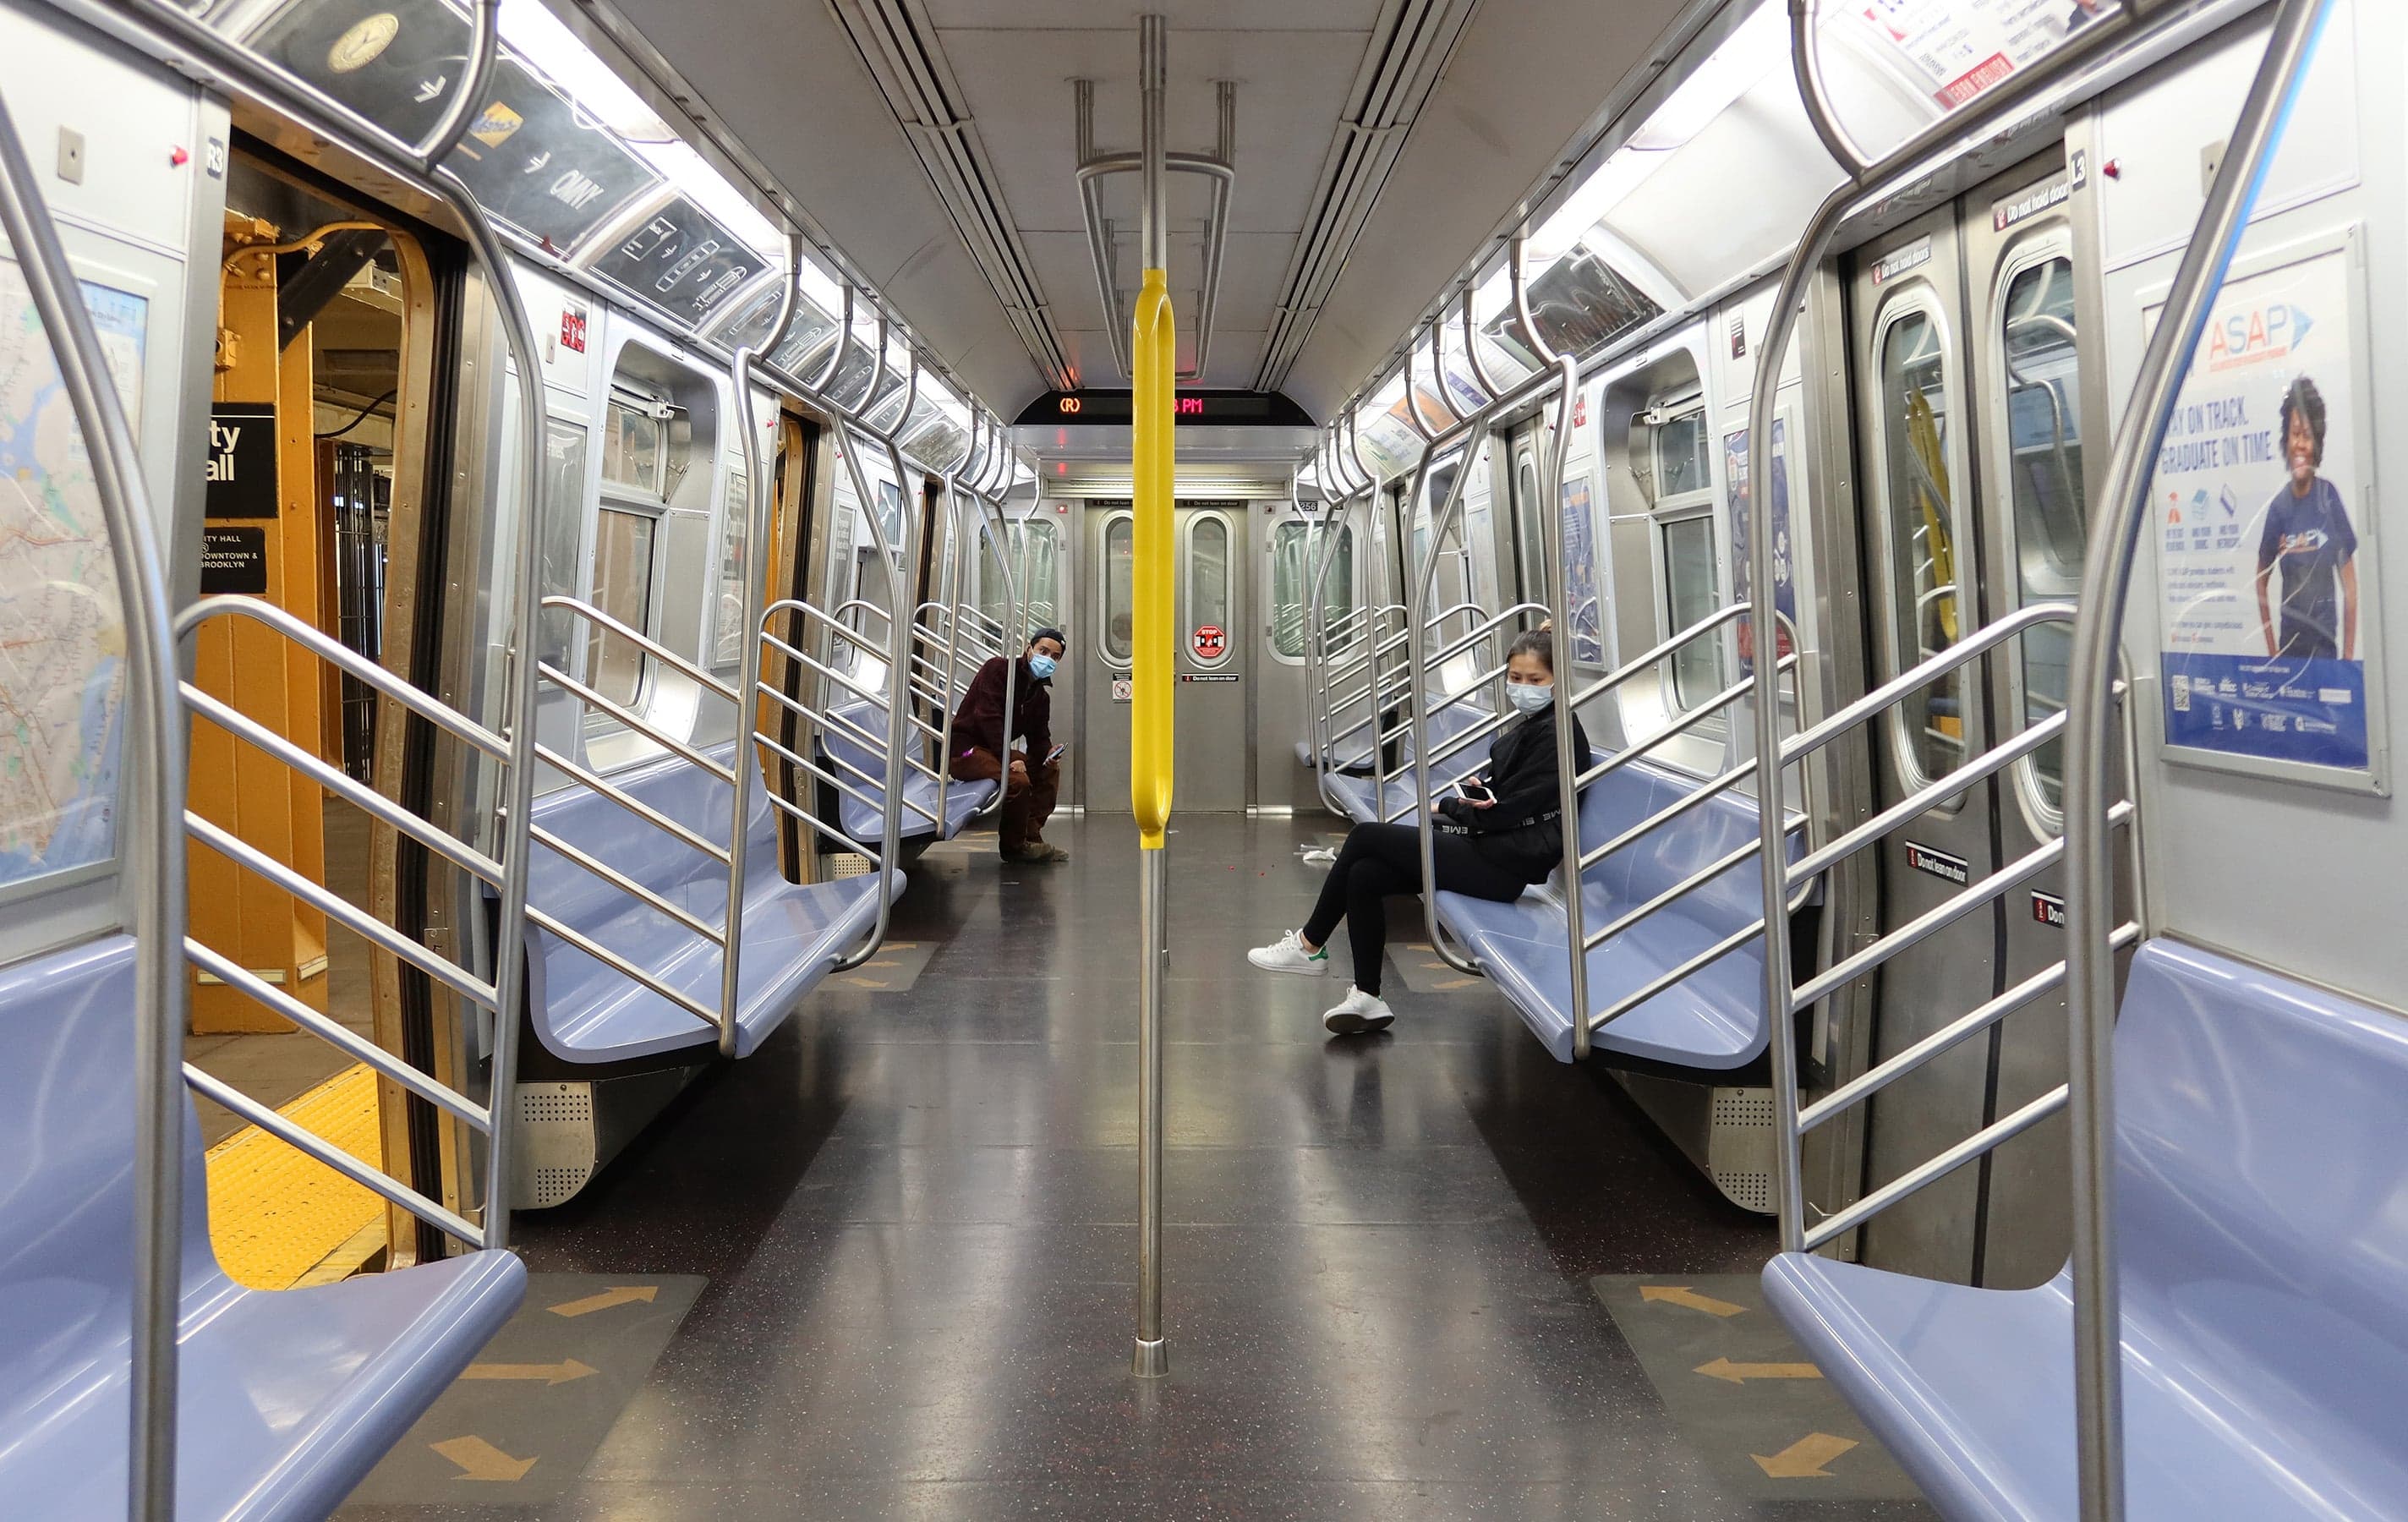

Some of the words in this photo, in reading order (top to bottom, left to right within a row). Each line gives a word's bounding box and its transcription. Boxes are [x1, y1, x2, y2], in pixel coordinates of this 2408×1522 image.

[2071, 156, 2085, 184] L3
[550, 170, 605, 210] OMNY
[2209, 304, 2289, 360] ASAP
[1059, 398, 1081, 413] (R)
[1183, 398, 1202, 413] PM
[2188, 405, 2203, 434] ON
[210, 420, 241, 453] ty
[206, 454, 234, 480] all
[2161, 439, 2219, 475] GRADUATE
[2223, 436, 2239, 466] ON
[1300, 501, 1317, 511] 256
[1917, 852, 1926, 868] Do
[1934, 857, 1946, 876] lean
[1953, 865, 1966, 882] door
